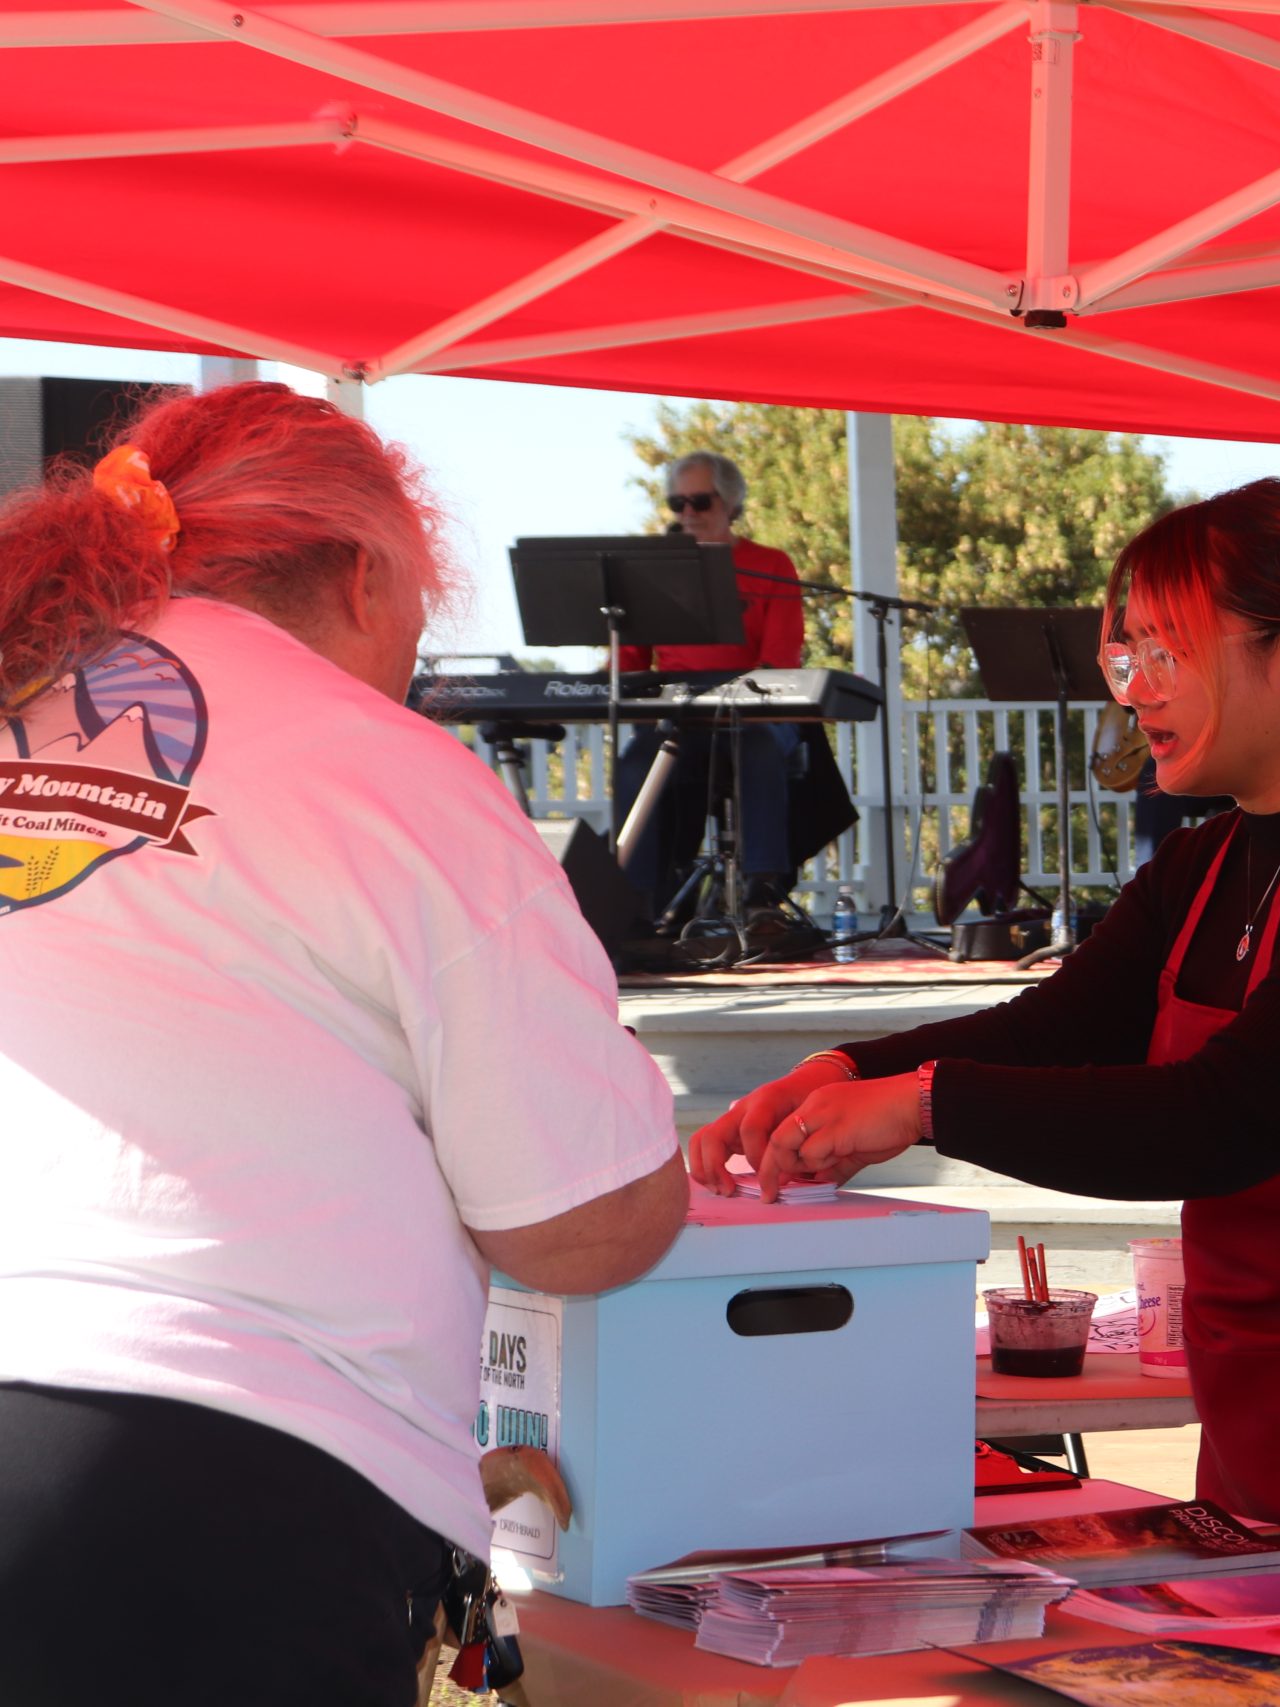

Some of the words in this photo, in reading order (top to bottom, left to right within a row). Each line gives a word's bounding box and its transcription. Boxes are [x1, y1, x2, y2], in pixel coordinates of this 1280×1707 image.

[14, 774, 168, 820] Mountain
[12, 816, 51, 831] Coal
[53, 818, 108, 838] Mines
[489, 1330, 527, 1373] DAYS
